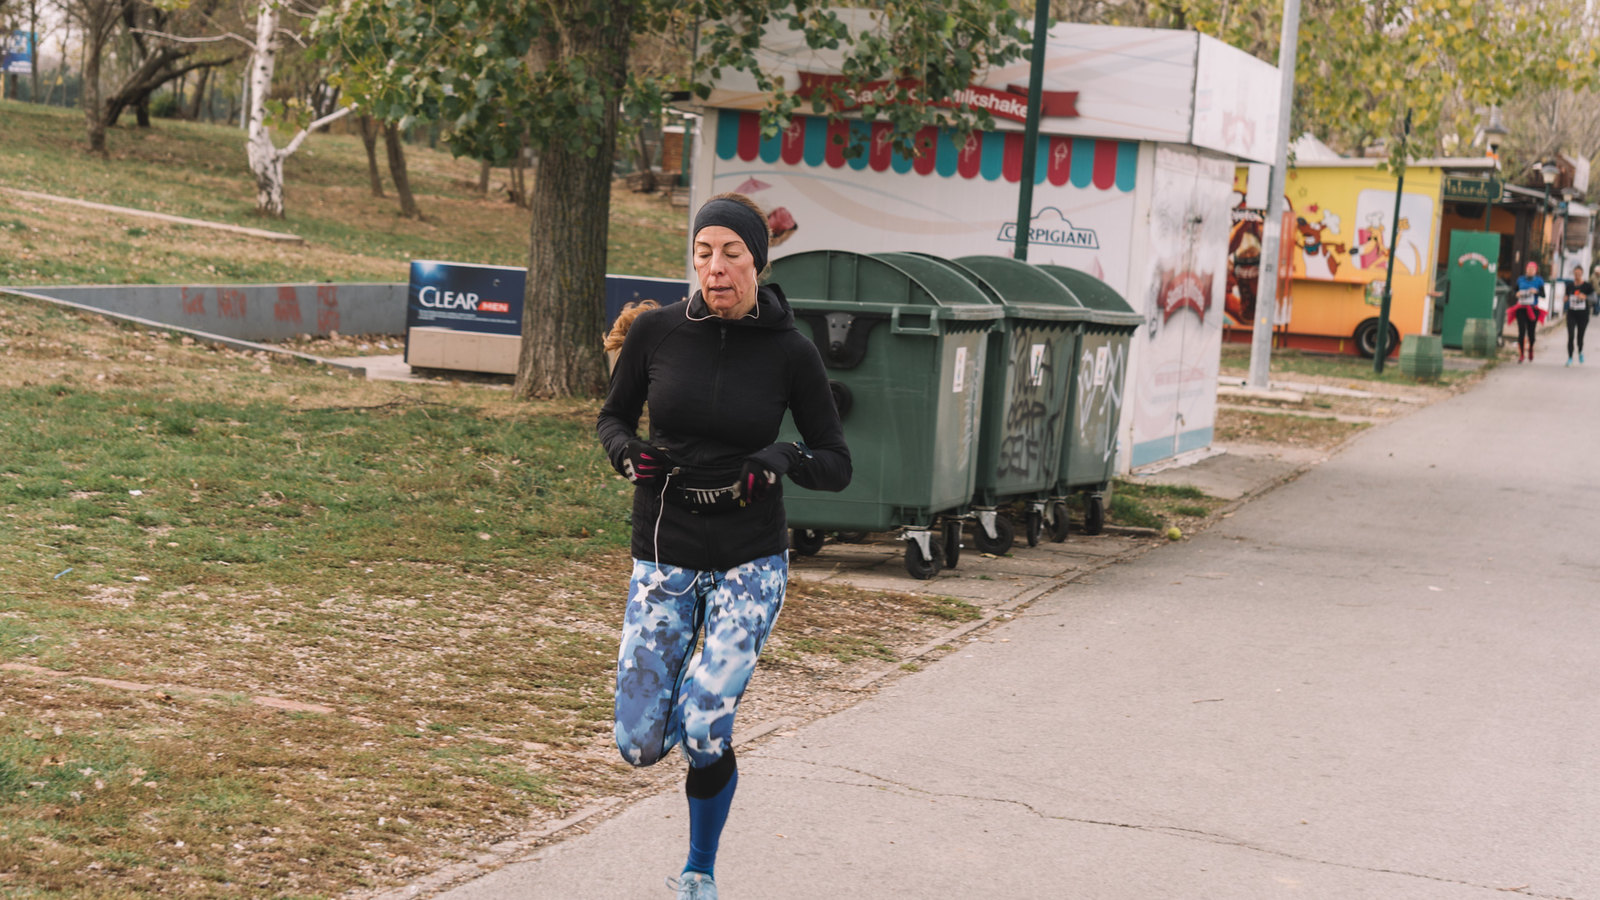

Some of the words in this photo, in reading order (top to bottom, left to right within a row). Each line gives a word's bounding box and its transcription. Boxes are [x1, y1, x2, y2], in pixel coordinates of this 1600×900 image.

[1004, 226, 1092, 245] CRPIGIANI
[418, 285, 479, 311] CLEAR
[483, 302, 509, 312] MEN
